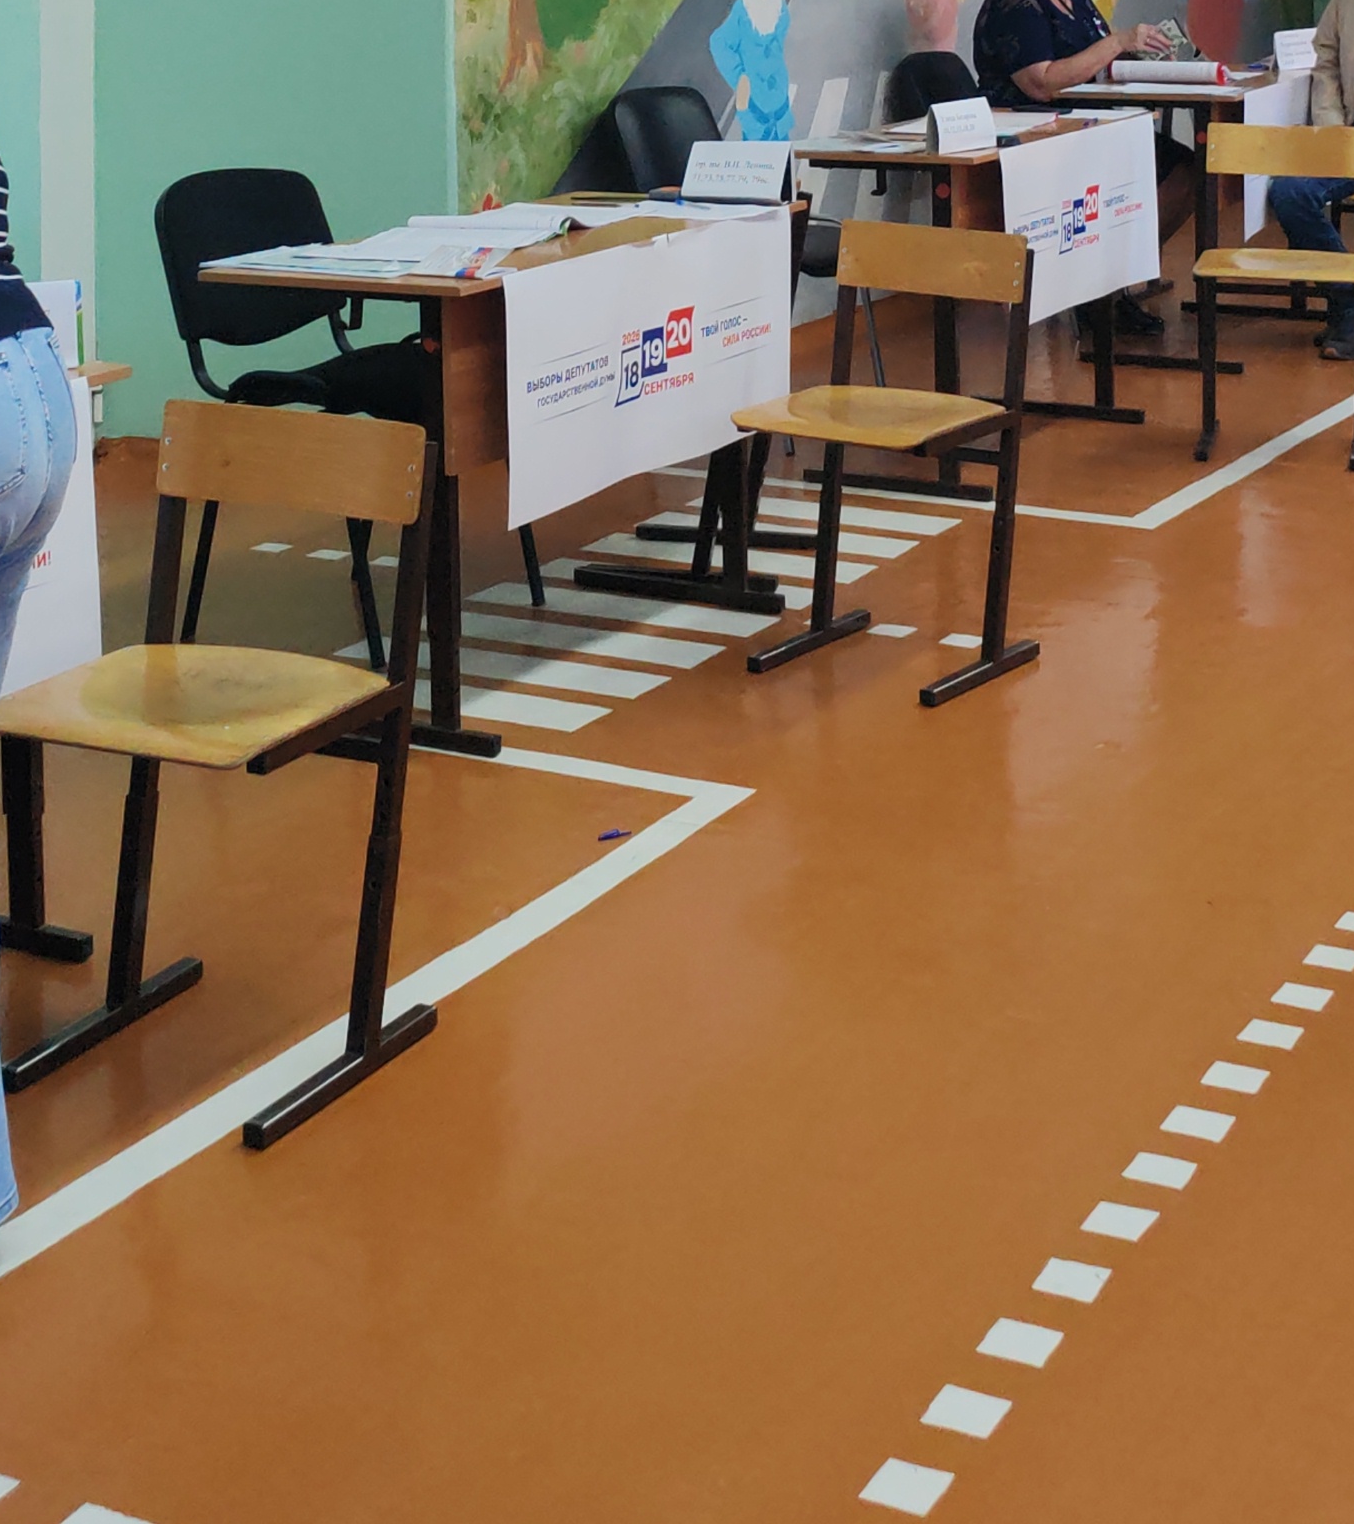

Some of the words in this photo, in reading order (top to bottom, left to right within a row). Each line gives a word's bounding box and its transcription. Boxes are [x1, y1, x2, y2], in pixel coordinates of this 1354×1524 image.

[1063, 222, 1072, 243] 18
[1073, 206, 1085, 228] 19
[1085, 193, 1098, 214] 20
[624, 360, 639, 391] 18
[643, 337, 663, 369] 19
[666, 317, 691, 349] 20
[722, 331, 740, 348] СИЛА
[526, 370, 563, 394] ВЫБОРЫ
[564, 355, 609, 384] ДЕПУТАТОВ
[643, 372, 695, 396] СЕНТЯБРЯ
[537, 378, 599, 409] ГОСУДАРСТВЕННОЙ
